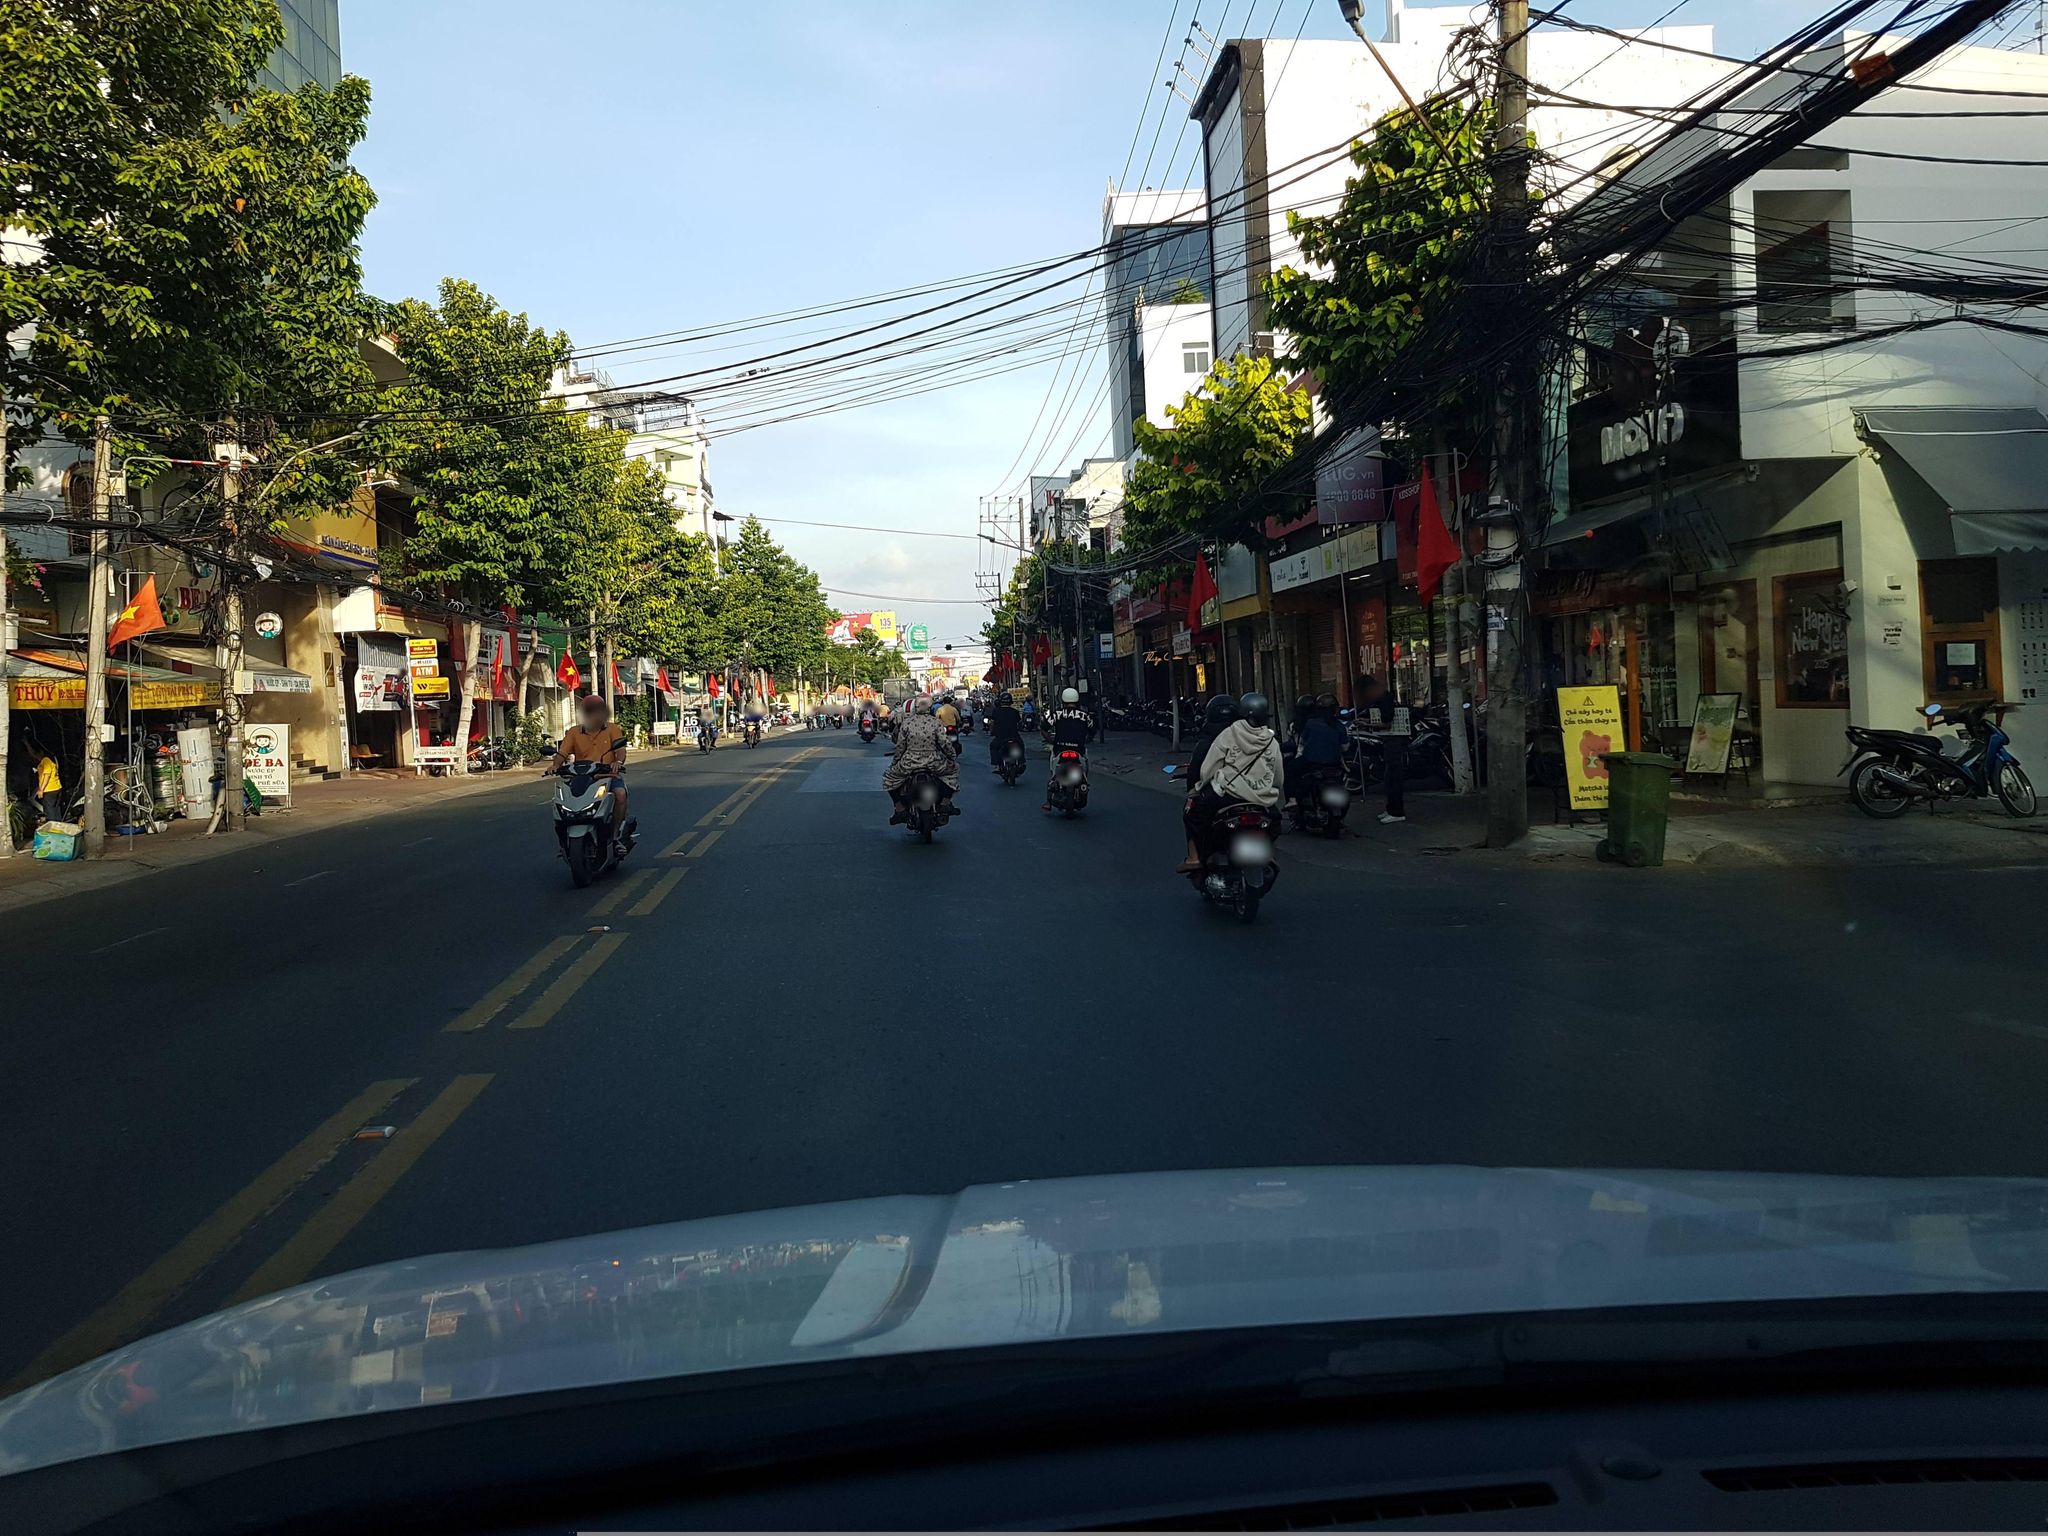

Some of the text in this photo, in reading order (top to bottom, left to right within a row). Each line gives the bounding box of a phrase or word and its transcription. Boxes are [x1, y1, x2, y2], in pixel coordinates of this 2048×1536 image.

[880, 618, 892, 627] 135
[1801, 606, 1842, 636] Happy
[1792, 627, 1820, 655] New
[1360, 644, 1377, 676] 304
[416, 666, 434, 676] ATM
[684, 716, 698, 727] 16
[265, 758, 284, 768] BA
[1579, 784, 1602, 793] Matcha
